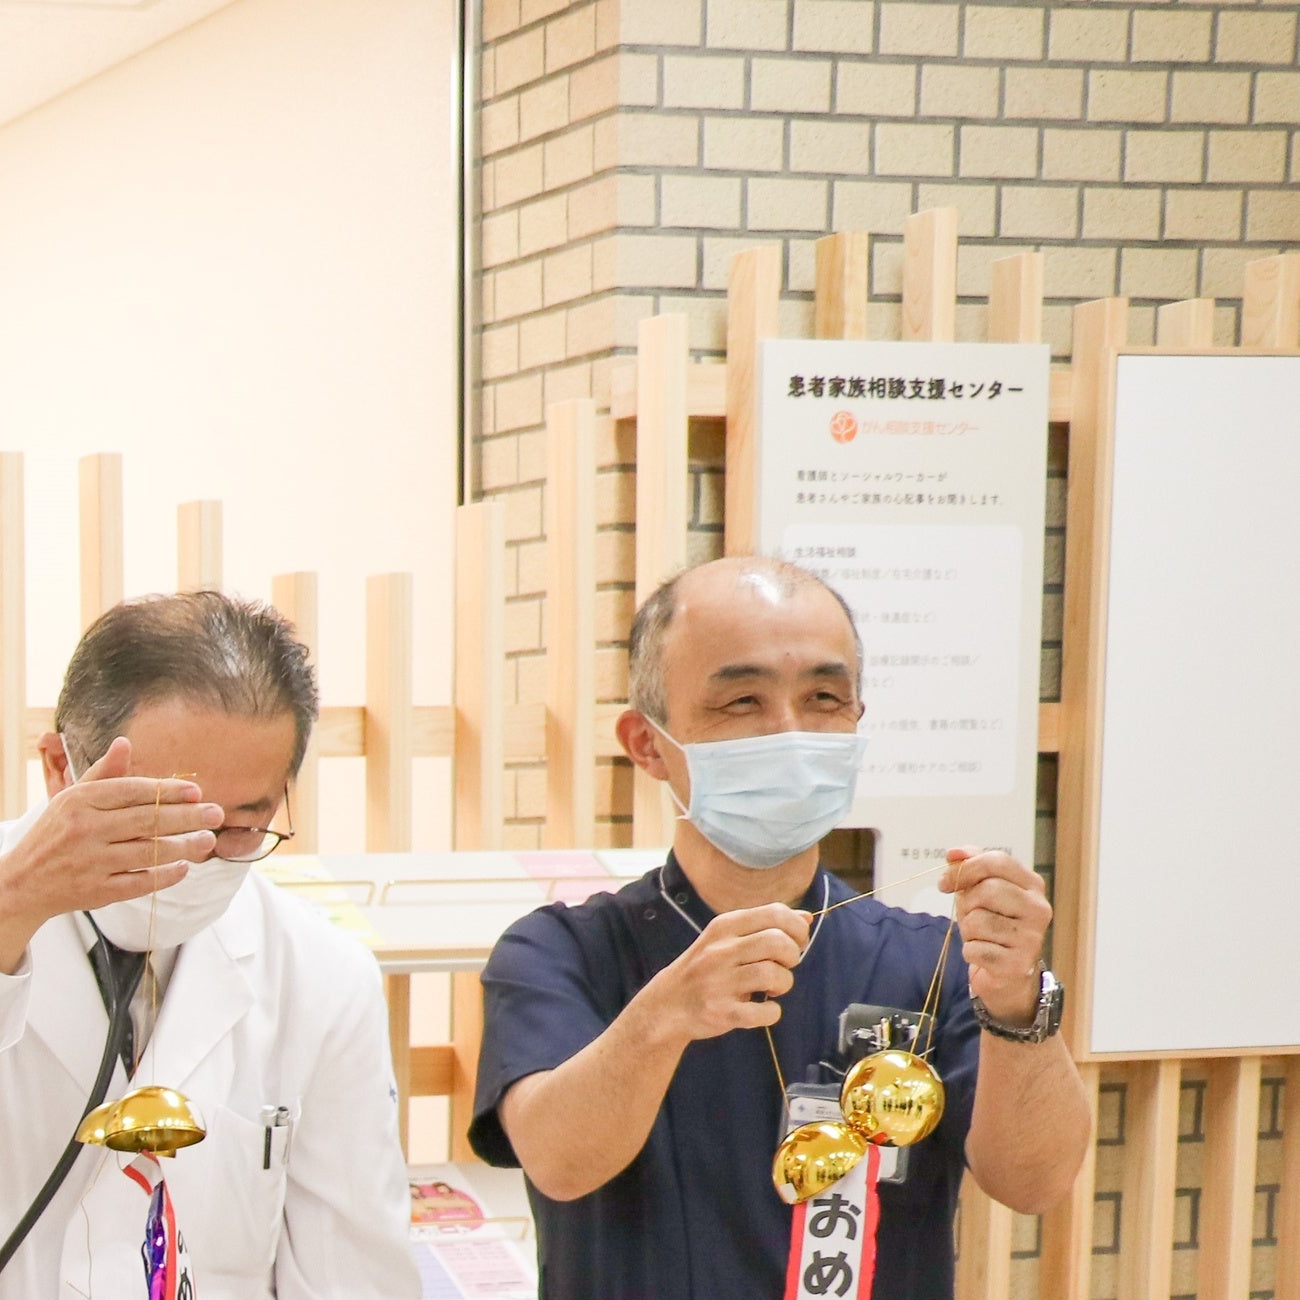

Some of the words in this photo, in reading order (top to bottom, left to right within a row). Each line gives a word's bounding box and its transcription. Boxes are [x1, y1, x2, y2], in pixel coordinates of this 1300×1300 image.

[787, 374, 1024, 400] 患者家族相談支援センター
[861, 420, 981, 436] がん相談支援センター
